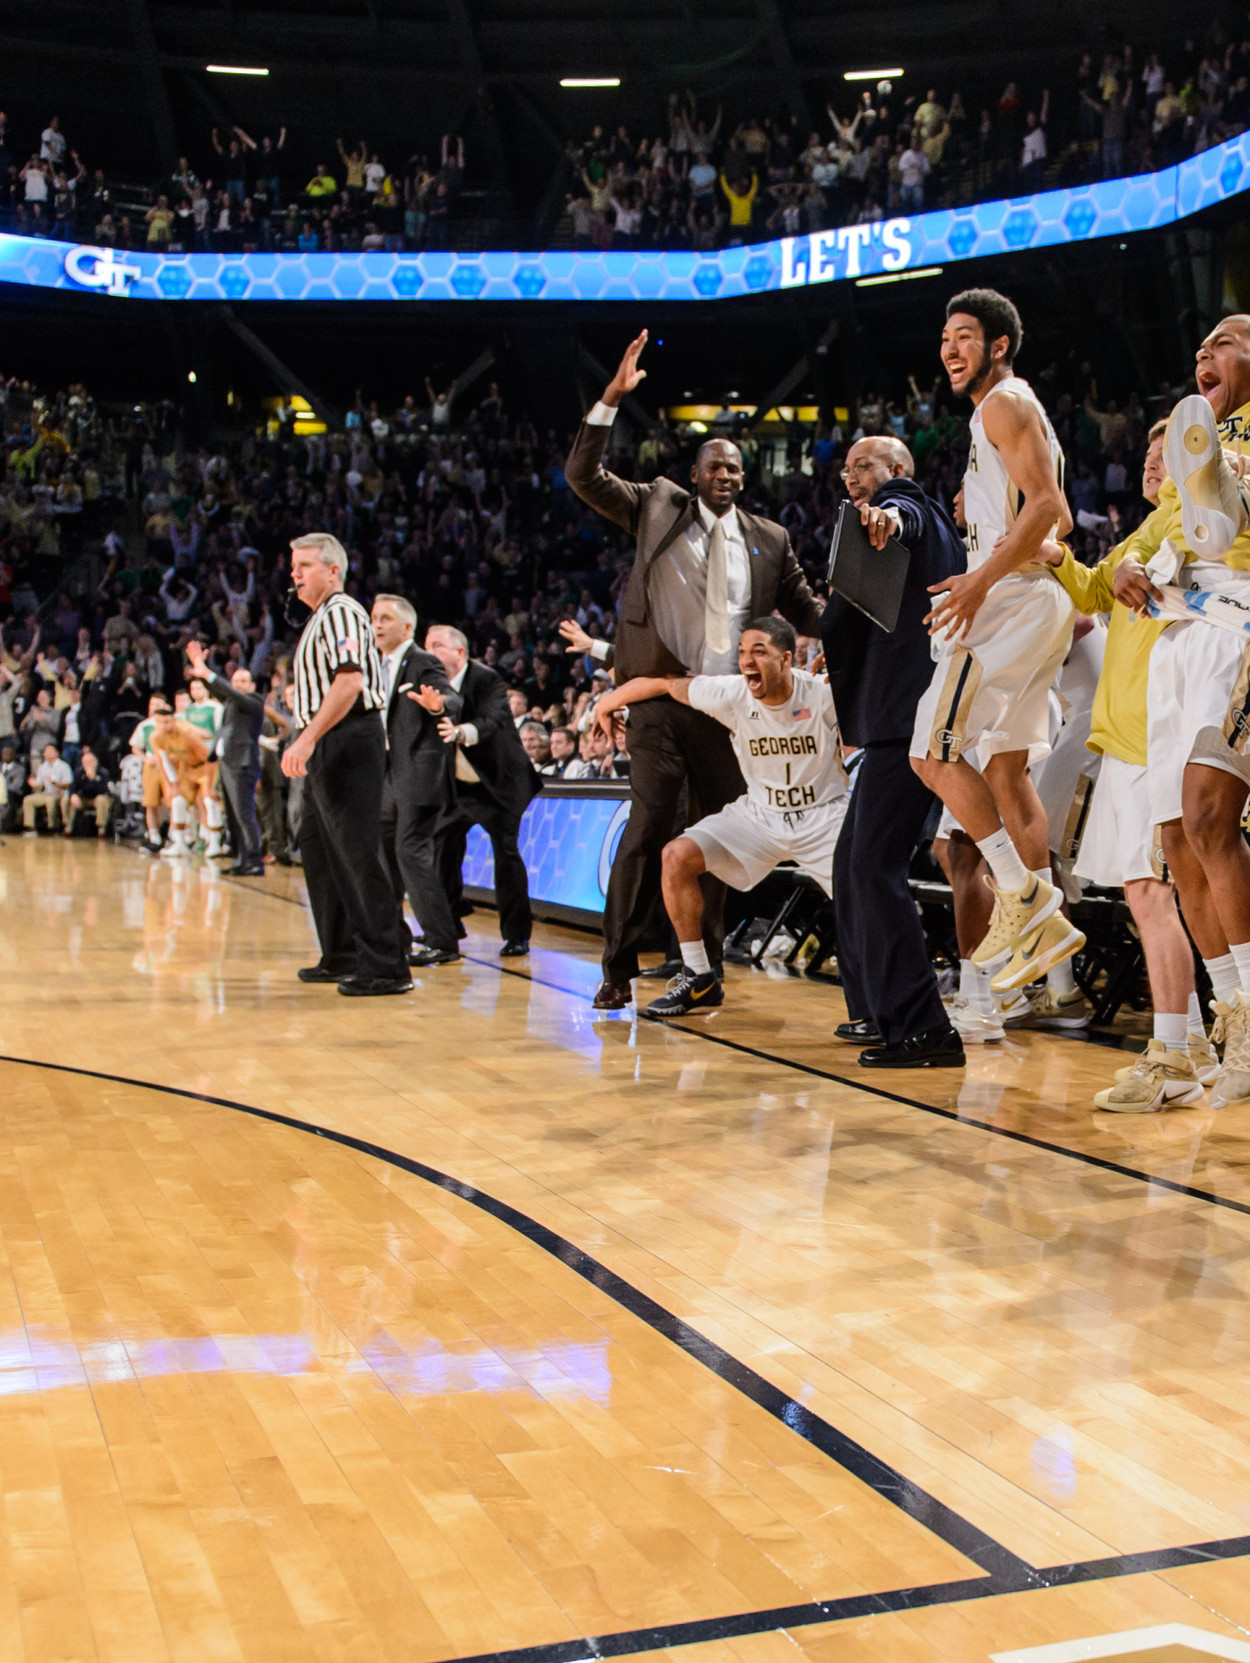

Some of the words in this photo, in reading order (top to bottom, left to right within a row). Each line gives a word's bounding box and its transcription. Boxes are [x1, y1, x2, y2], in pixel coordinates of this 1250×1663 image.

[780, 217, 911, 290] LET'S
[64, 245, 141, 298] GT
[1231, 708, 1250, 739] GT
[749, 735, 818, 757] GEORGIA
[936, 729, 963, 749] GT
[764, 785, 816, 808] TECH
